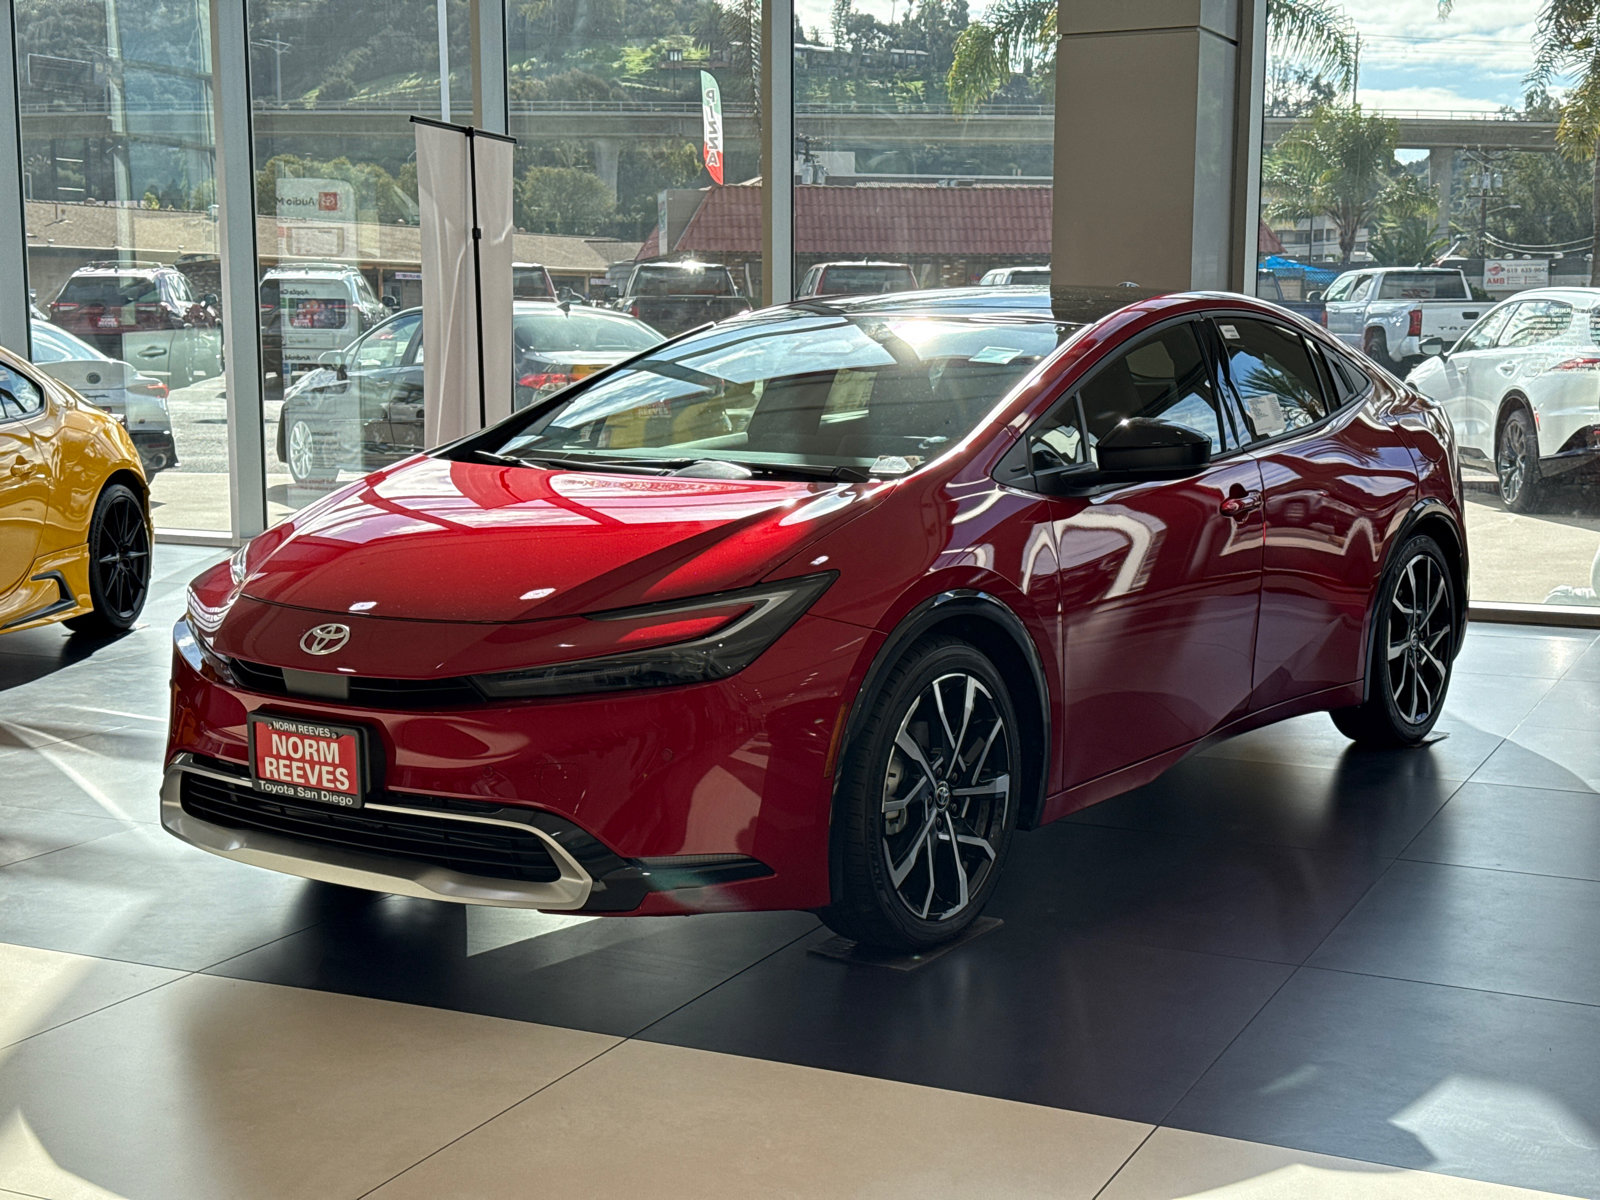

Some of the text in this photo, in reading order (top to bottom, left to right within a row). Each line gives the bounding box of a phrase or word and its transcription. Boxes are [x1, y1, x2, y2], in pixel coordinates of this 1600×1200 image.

[272, 720, 331, 738] NORM REEVES
[271, 733, 340, 764] NORM
[264, 756, 350, 790] REEVES
[259, 780, 353, 806] Toyota San Diego
